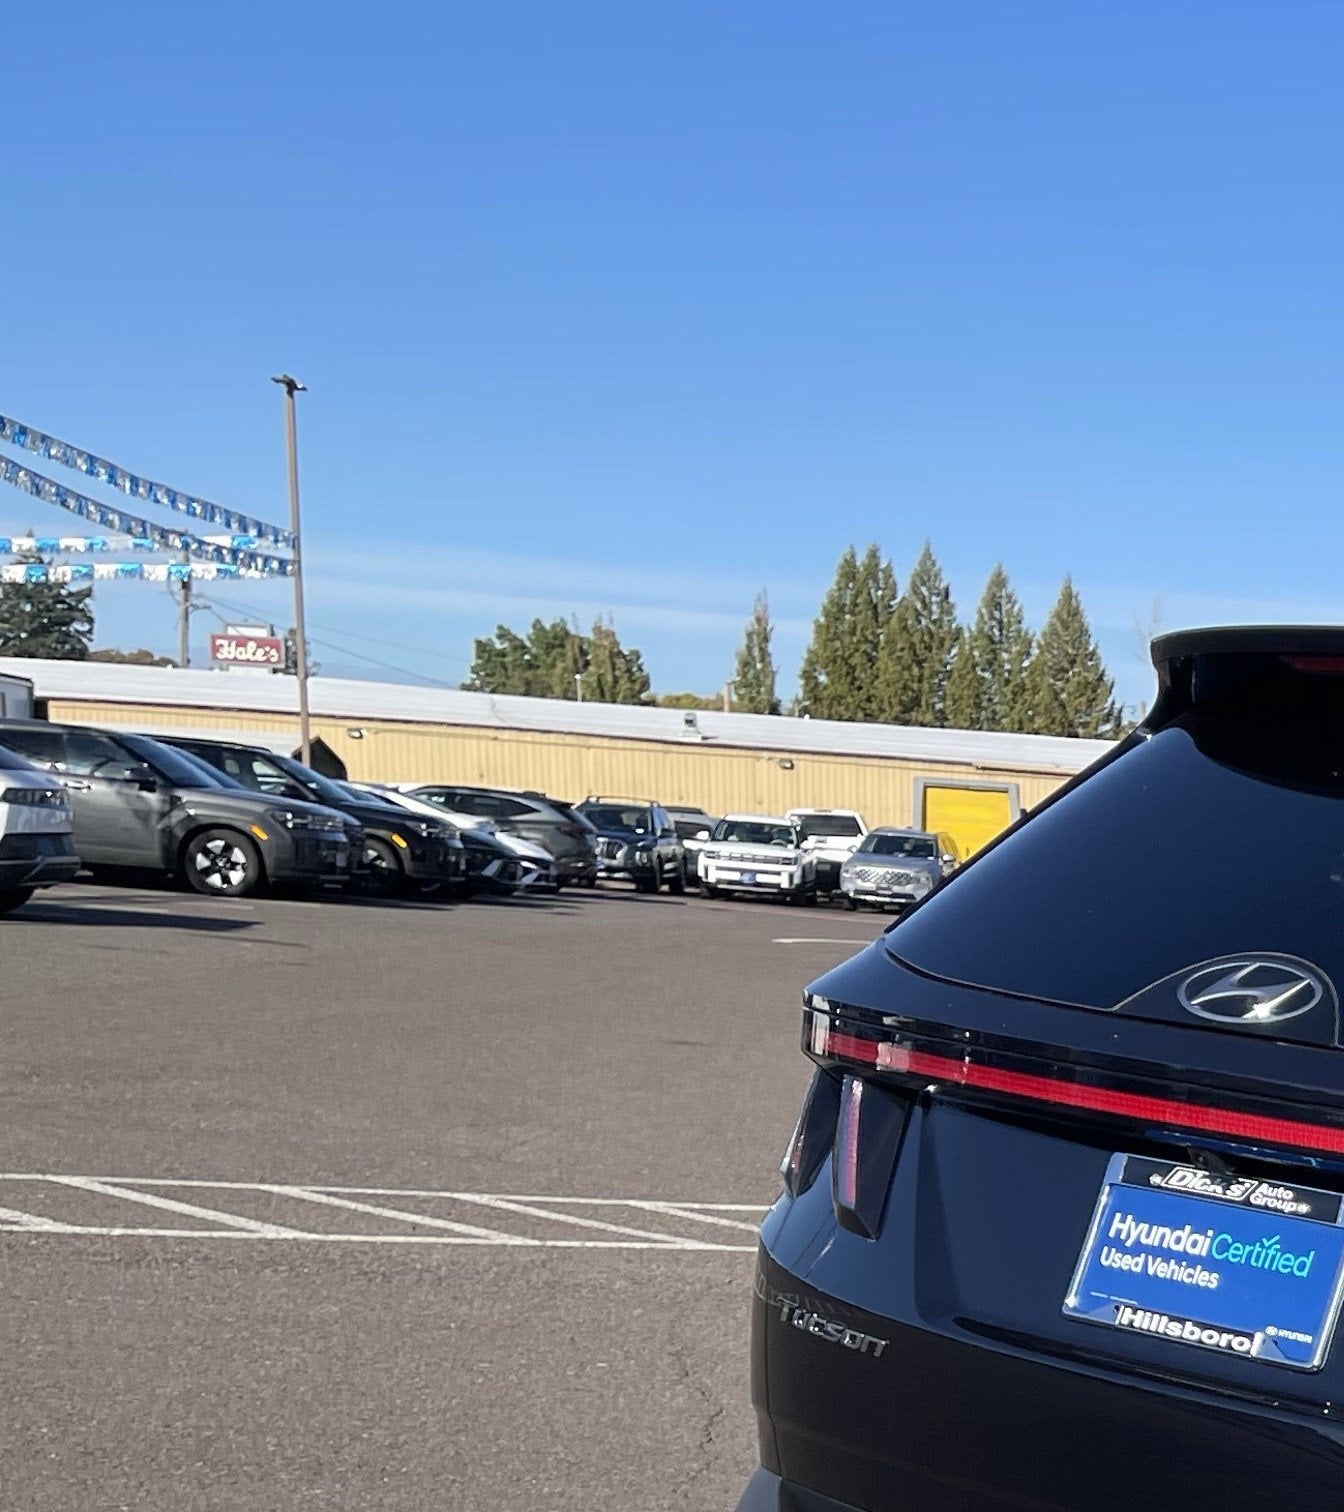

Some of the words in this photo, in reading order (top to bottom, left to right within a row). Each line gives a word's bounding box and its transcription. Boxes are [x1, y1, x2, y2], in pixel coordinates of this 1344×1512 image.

[1250, 1193, 1298, 1213] Group
[1254, 1183, 1294, 1200] Auto
[1108, 1212, 1214, 1258] Hyundai
[1211, 1234, 1315, 1278] Certified
[1100, 1246, 1146, 1273] Used
[1147, 1255, 1220, 1289] Vehicles
[1120, 1306, 1251, 1352] Hillsboro
